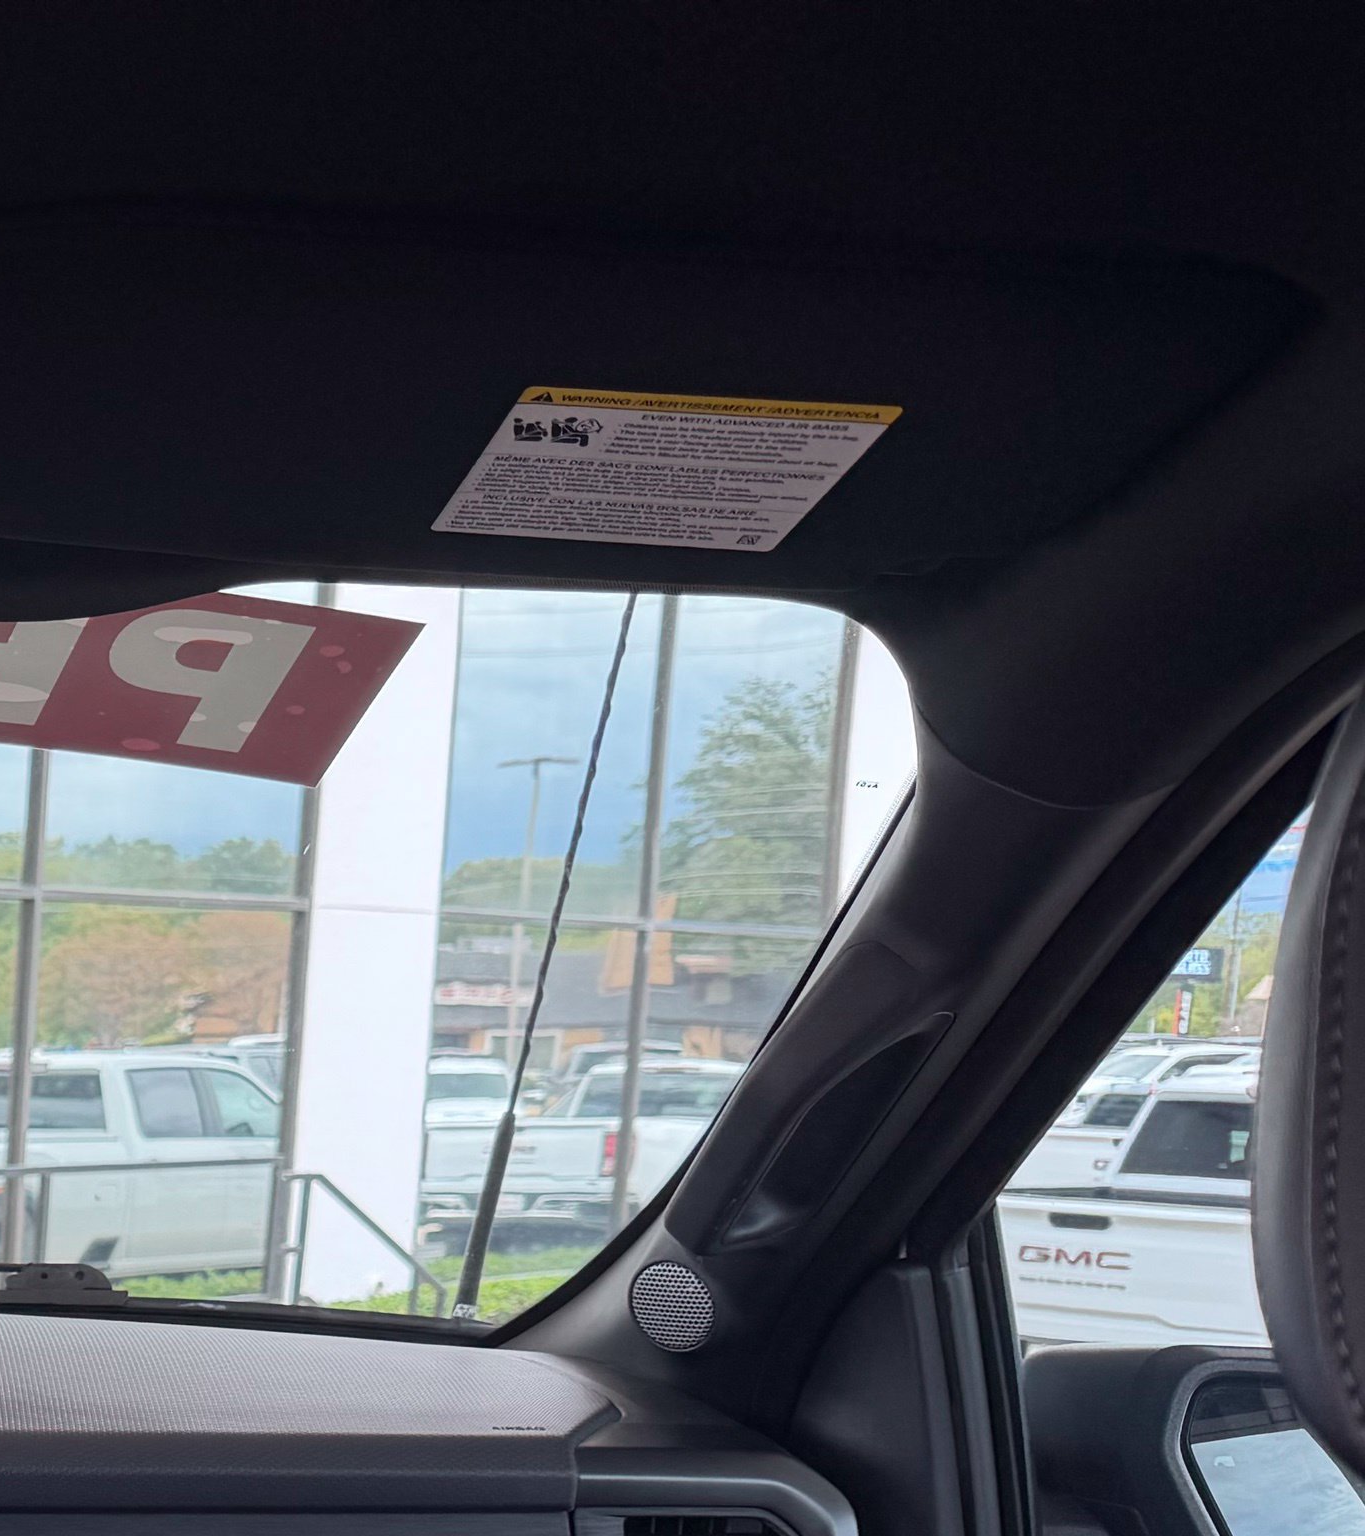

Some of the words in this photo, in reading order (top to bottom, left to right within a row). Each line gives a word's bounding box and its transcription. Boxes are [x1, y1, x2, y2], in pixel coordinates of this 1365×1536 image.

[561, 394, 631, 406] WARNING
[640, 398, 766, 414] AVERTISSEMENT
[641, 414, 676, 422] EVEN
[679, 415, 712, 424] WITH
[714, 417, 785, 429] ADVANCED
[787, 421, 810, 430] AIR
[812, 423, 850, 432] BAGS
[533, 457, 567, 465] AVEC
[569, 459, 595, 467] DES
[597, 461, 632, 469] SACS
[635, 463, 718, 476] GONFLABLES
[482, 494, 548, 504] INCLUSIVE
[605, 502, 654, 511] NUEVAS
[657, 504, 707, 514] BOLSAS
[708, 507, 726, 515] DE
[728, 508, 758, 516] AIRE
[1019, 1245, 1132, 1271] GMC
